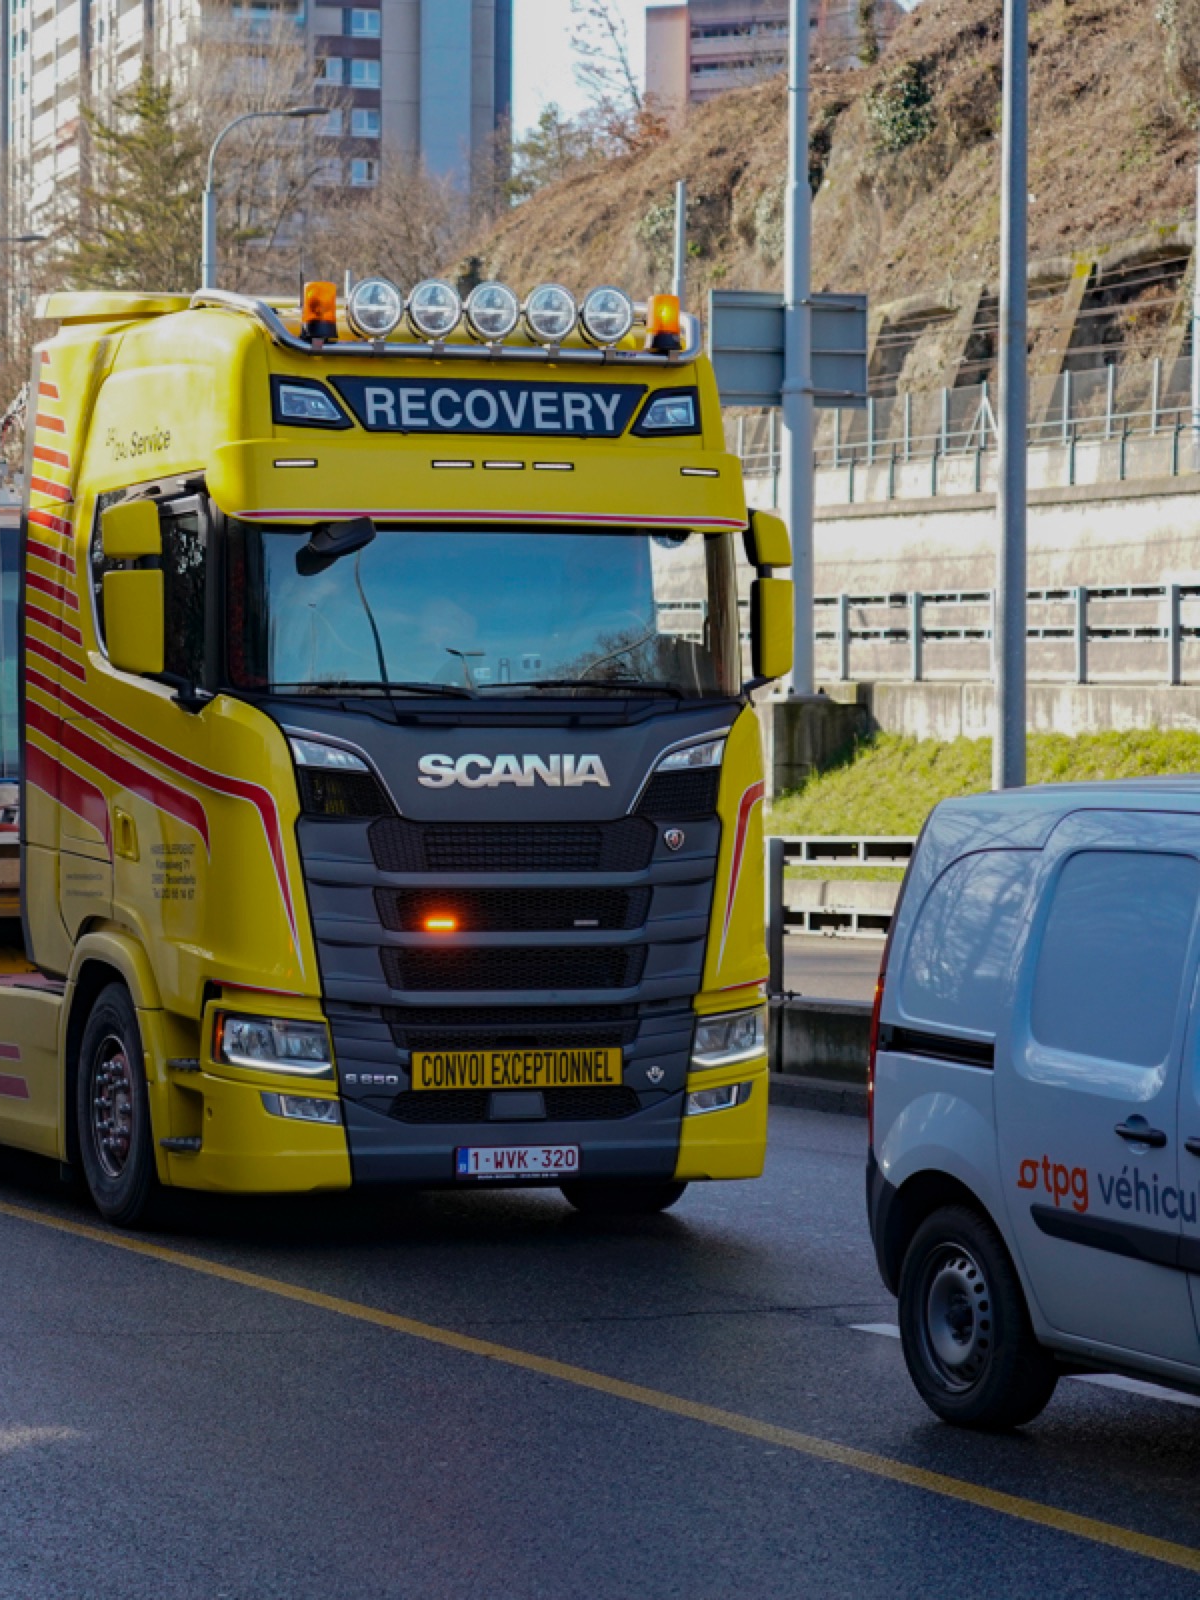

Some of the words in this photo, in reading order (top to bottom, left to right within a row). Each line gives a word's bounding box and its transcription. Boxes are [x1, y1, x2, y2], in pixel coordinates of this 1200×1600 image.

[364, 386, 622, 431] RECOVERY
[130, 425, 171, 459] Service
[417, 753, 611, 789] SCANIA
[421, 1053, 486, 1087] CONVOI
[491, 1050, 614, 1085] EXCEPTIONNEL
